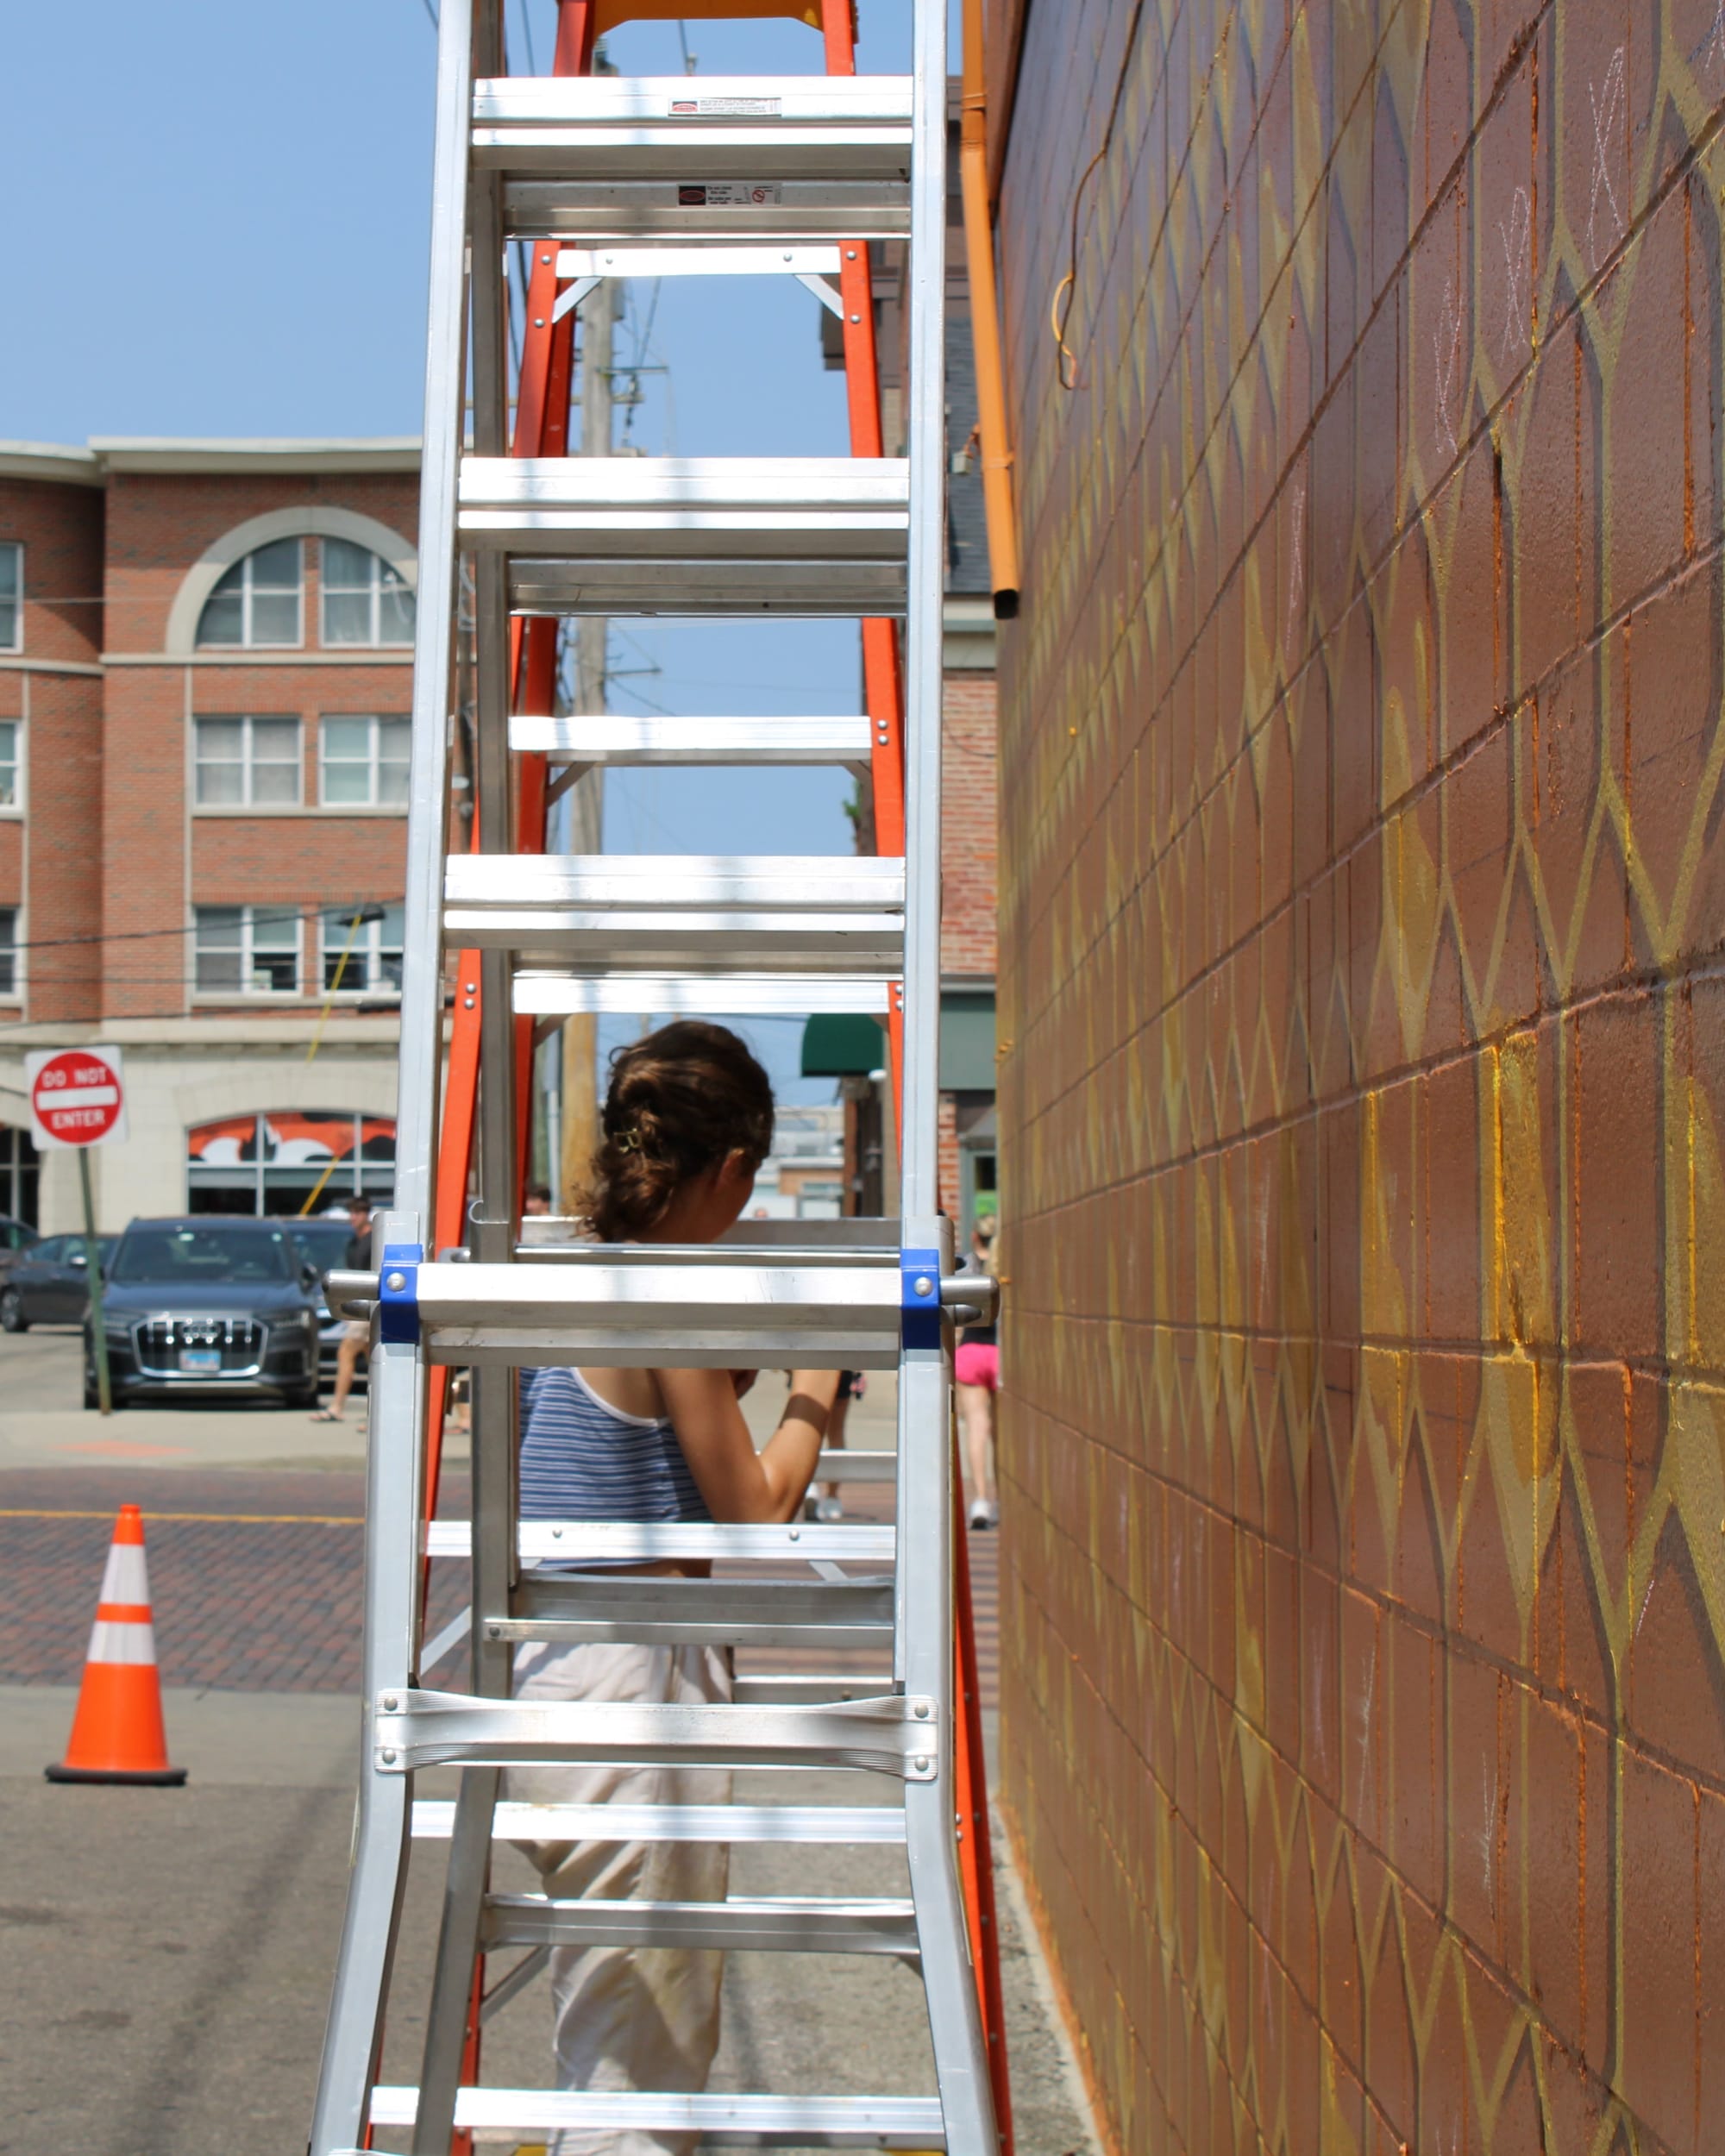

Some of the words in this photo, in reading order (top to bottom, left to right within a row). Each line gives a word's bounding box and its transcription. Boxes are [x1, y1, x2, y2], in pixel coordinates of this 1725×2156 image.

[43, 1070, 66, 1087] DO
[75, 1068, 106, 1084] NOT
[53, 1110, 104, 1129] ENTER
